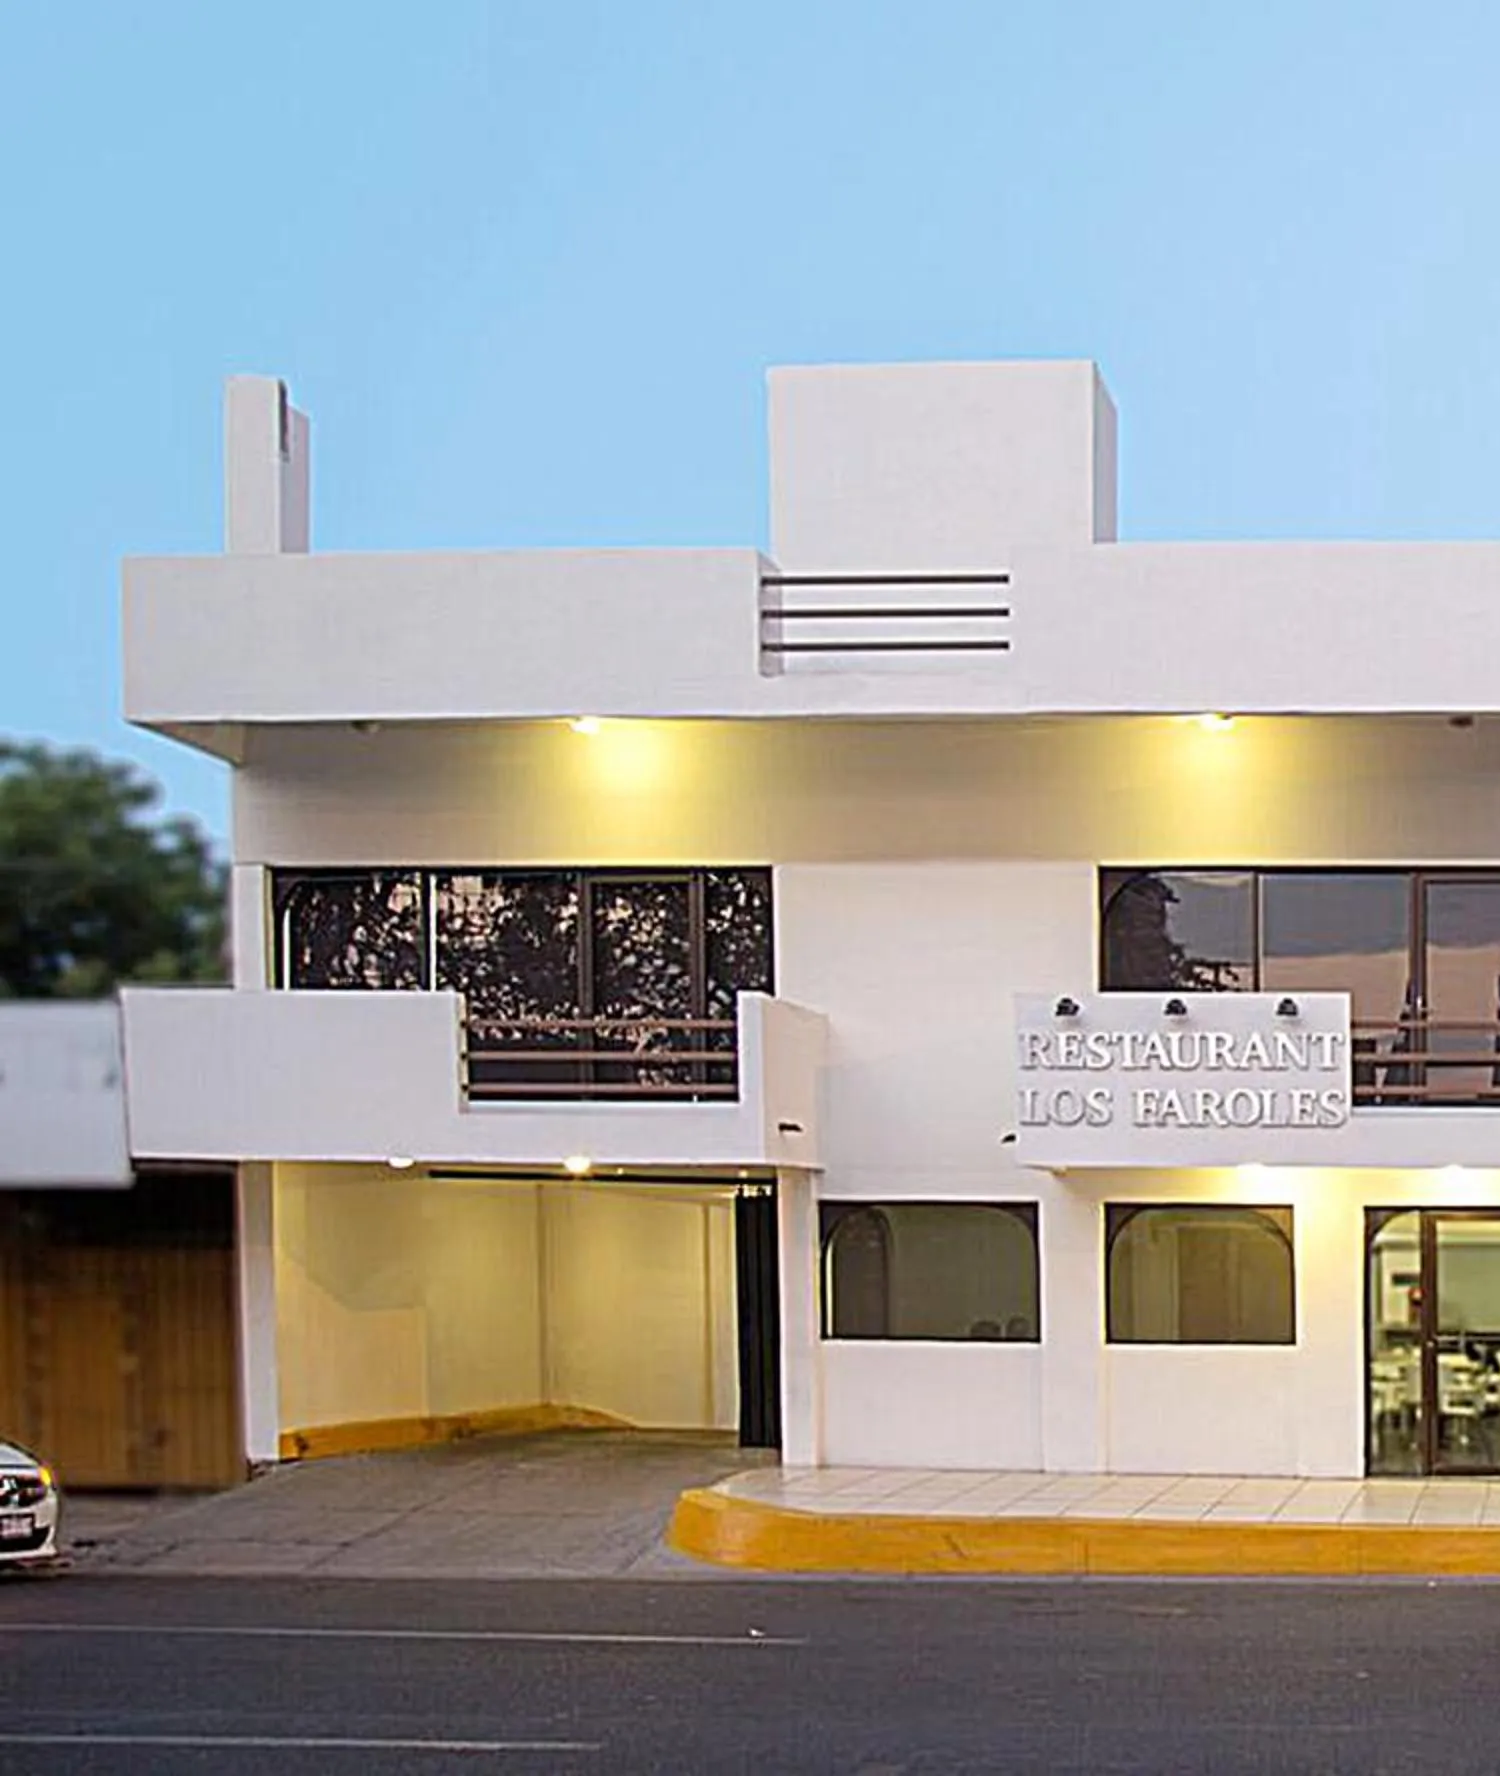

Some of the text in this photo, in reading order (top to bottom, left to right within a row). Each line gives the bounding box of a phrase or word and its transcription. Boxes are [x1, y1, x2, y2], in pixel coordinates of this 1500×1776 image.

[1019, 1031, 1344, 1071] RESTAURANT
[1019, 1087, 1347, 1129] LOS FAROLES
